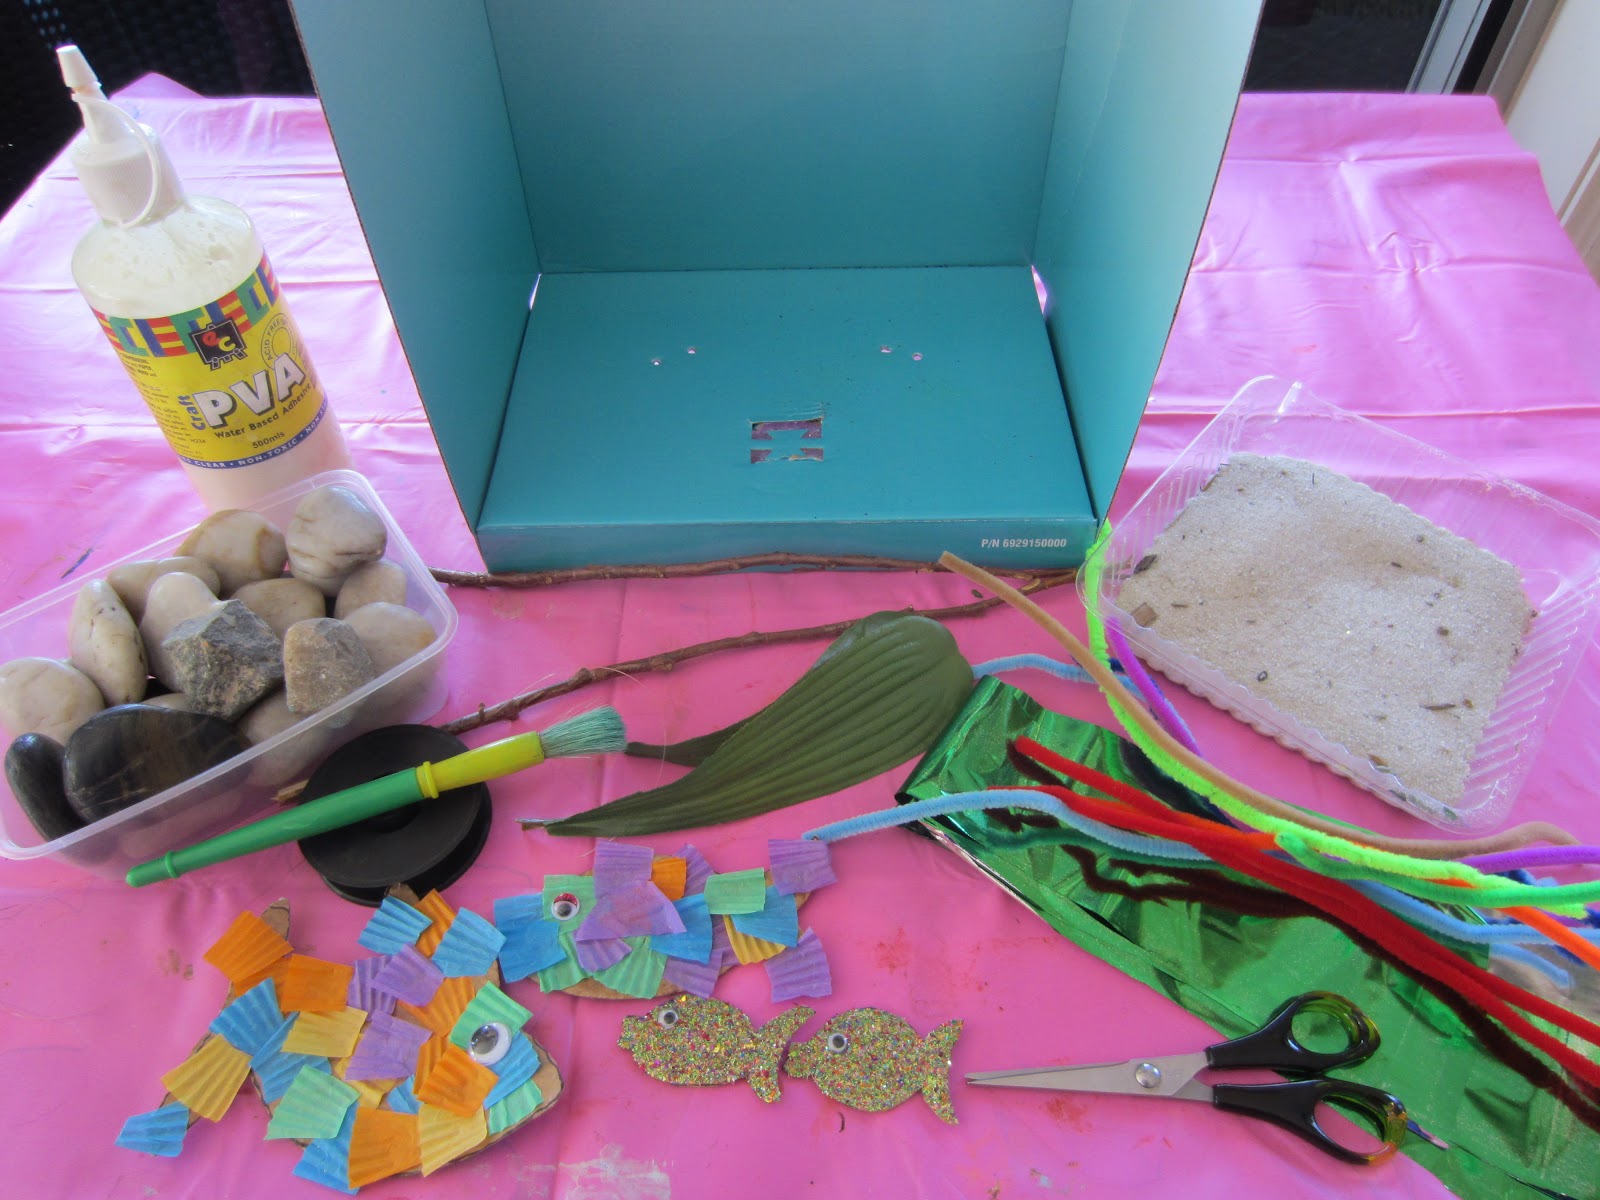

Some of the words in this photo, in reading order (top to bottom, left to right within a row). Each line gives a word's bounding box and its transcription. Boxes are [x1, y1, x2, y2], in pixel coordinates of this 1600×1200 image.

[267, 318, 281, 337] FREE
[264, 339, 273, 361] ACID
[192, 352, 306, 430] PVA
[178, 395, 207, 431] Craft
[214, 427, 246, 439] Water
[248, 412, 280, 431] Based
[282, 383, 312, 415] Adhesive
[194, 460, 227, 468] CLEAR
[238, 438, 298, 466] NON-TOXIC
[305, 416, 320, 434] NON
[252, 431, 285, 449] 500mls
[981, 538, 1000, 549] P/N
[1002, 538, 1067, 548] 6929150000
